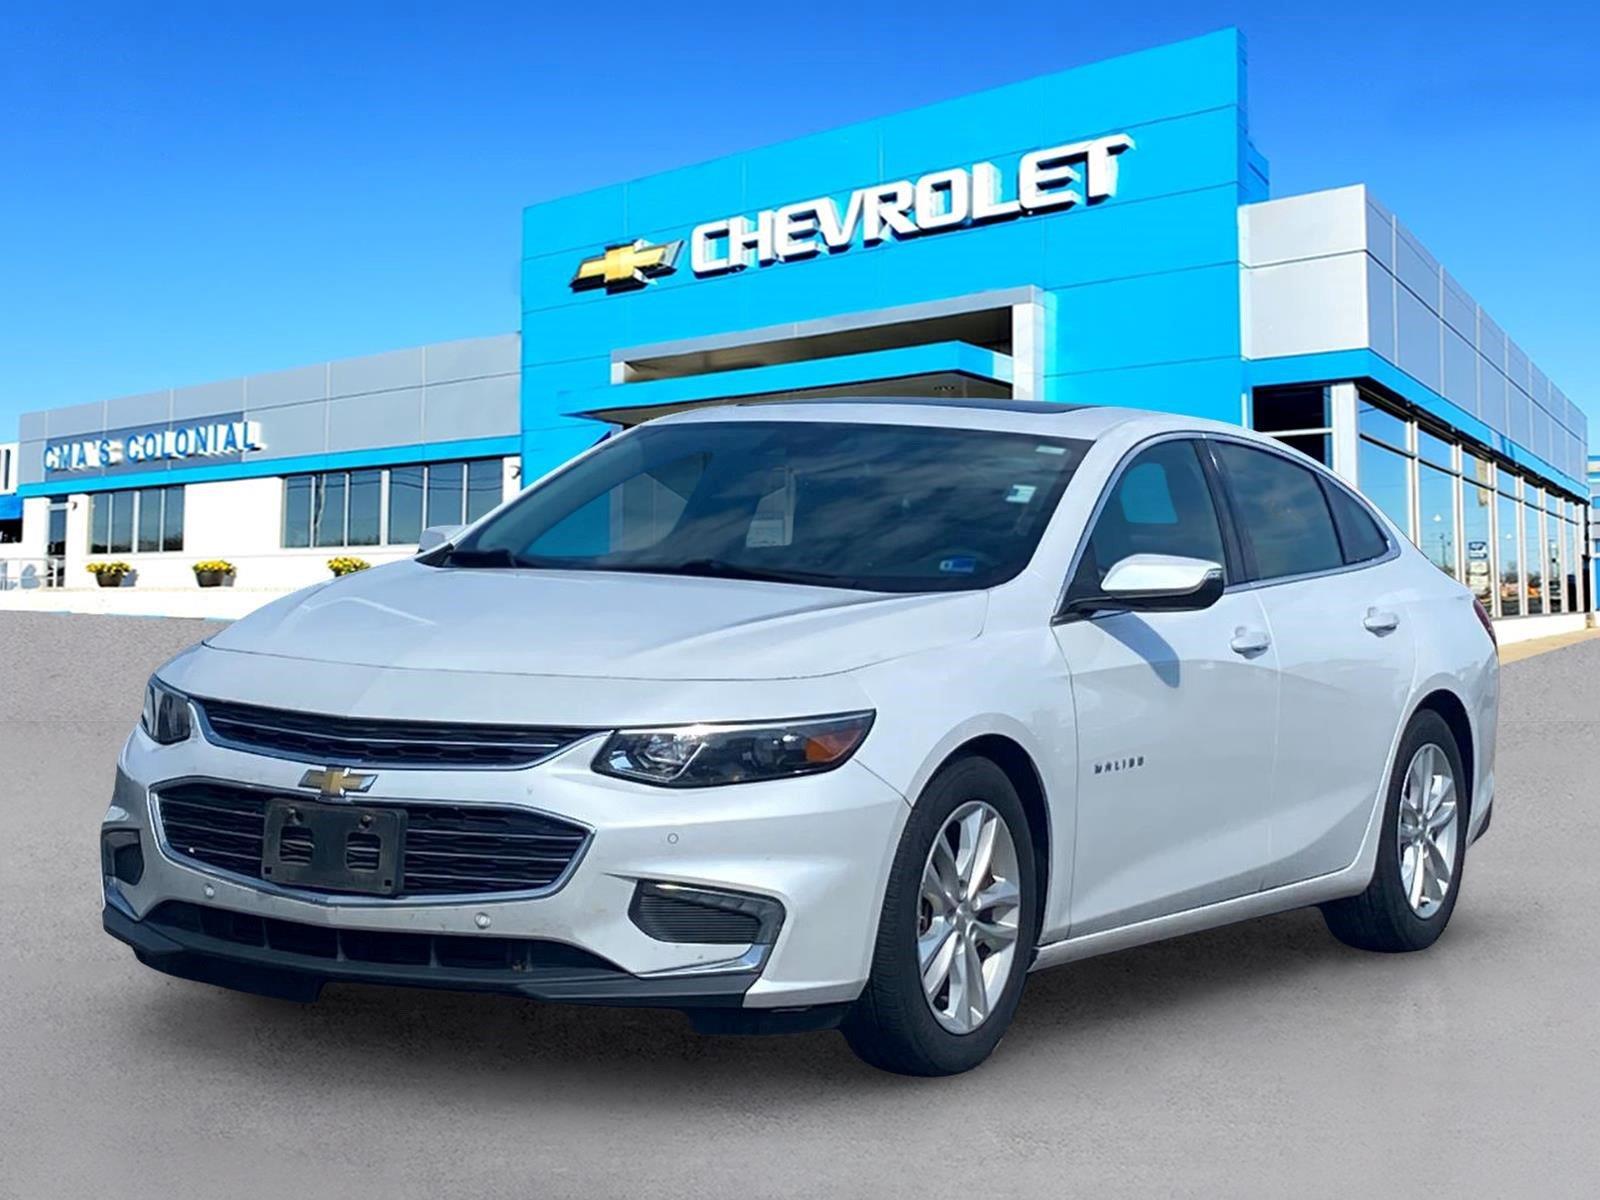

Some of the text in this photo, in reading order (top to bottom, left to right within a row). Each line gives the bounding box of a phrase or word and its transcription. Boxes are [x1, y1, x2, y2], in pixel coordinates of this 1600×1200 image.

[690, 133, 1134, 278] CHEVROLET
[126, 421, 262, 464] COLONIAL
[1093, 755, 1144, 775] MALIBU
